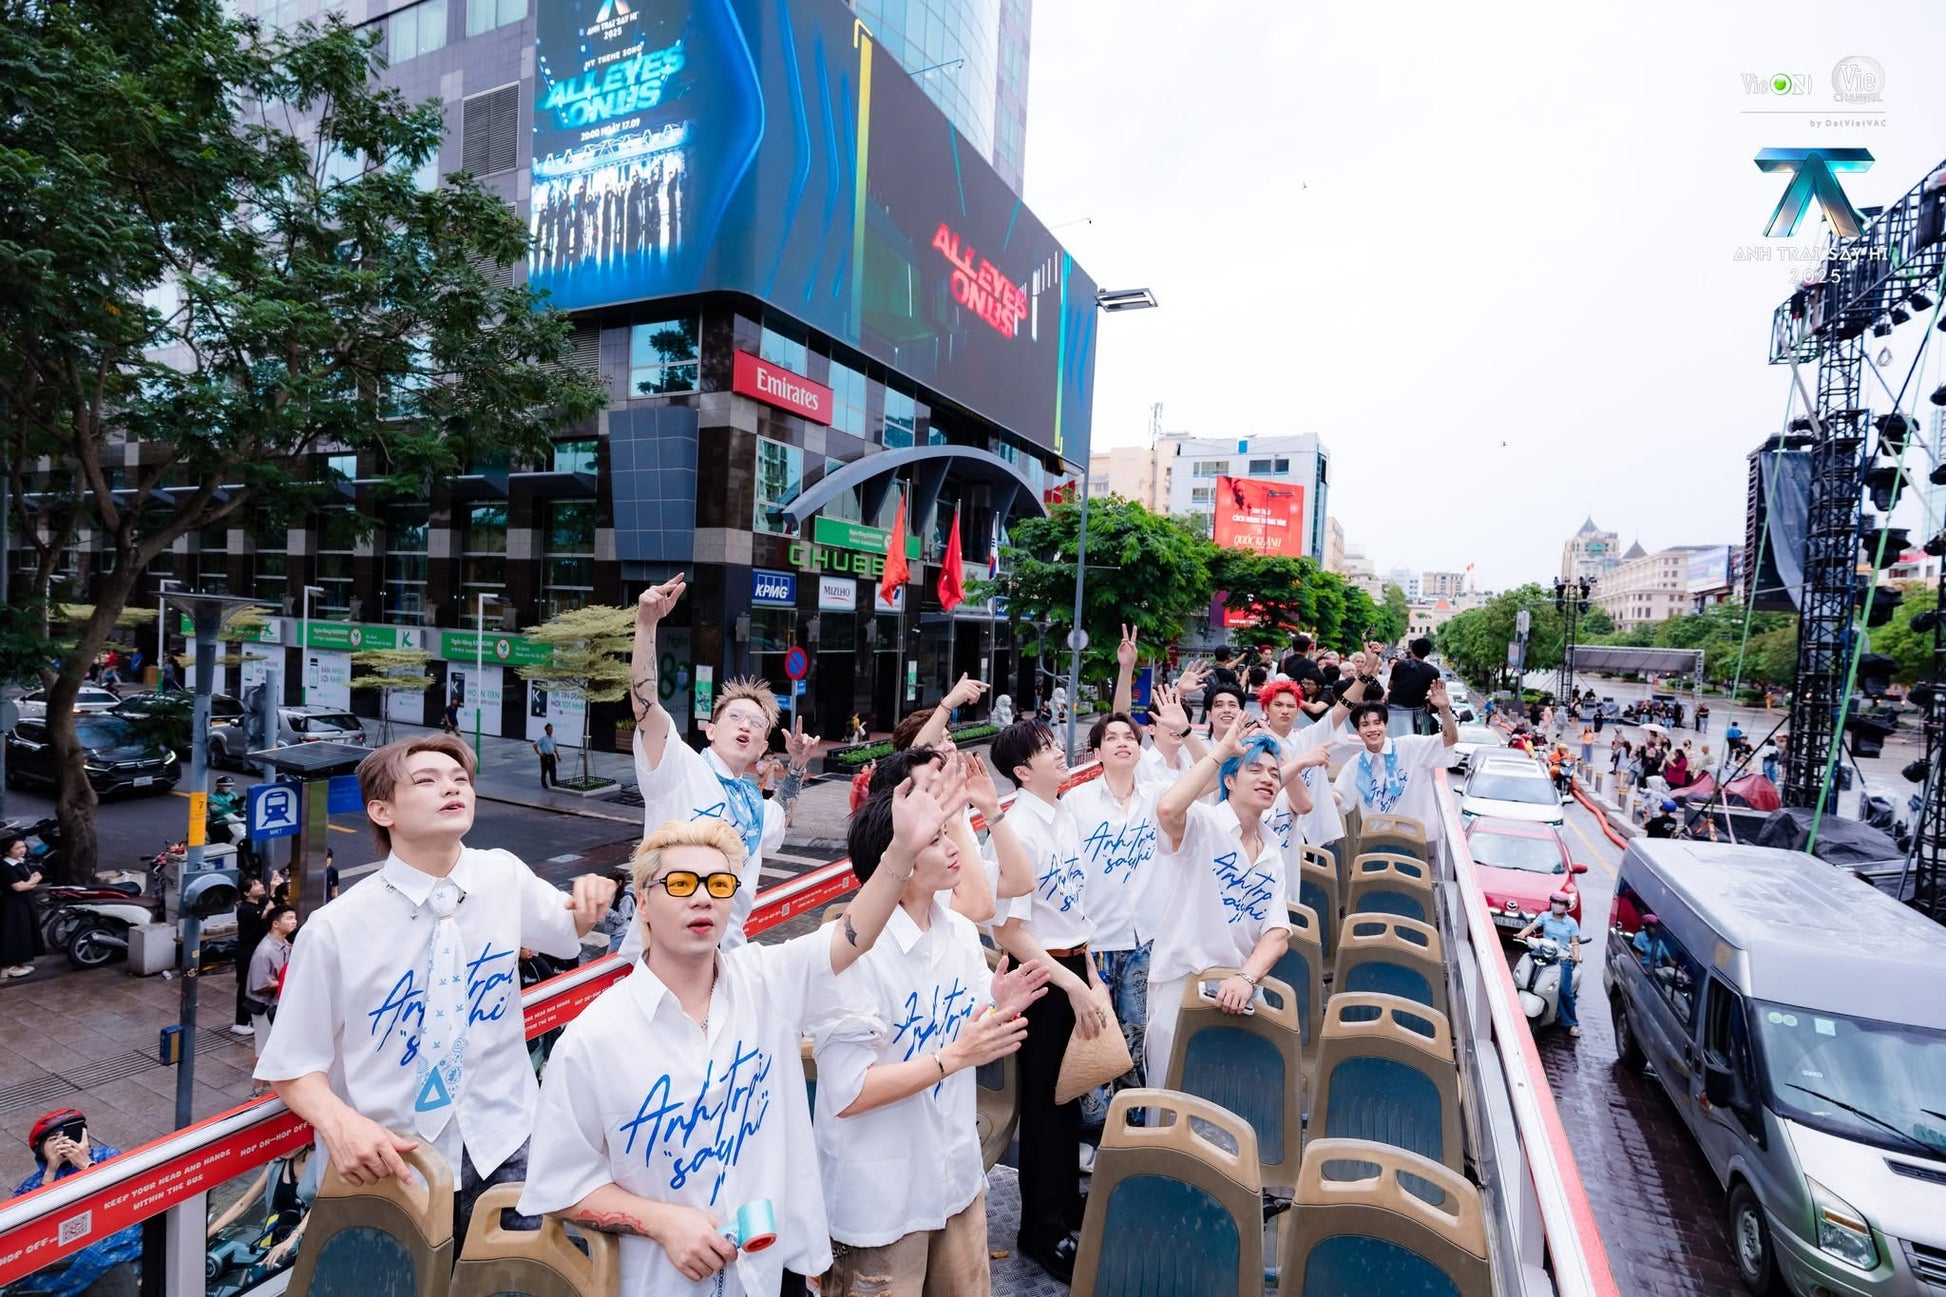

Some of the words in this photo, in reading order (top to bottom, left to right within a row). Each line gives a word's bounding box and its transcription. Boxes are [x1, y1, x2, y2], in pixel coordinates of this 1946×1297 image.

[598, 51, 620, 64] THEME
[622, 44, 643, 57] SONG
[602, 46, 684, 93] EYES
[757, 366, 818, 411] Emirates
[755, 583, 789, 599] KPMG
[532, 690, 540, 702] K
[1084, 822, 1130, 862] Anh
[1213, 851, 1254, 890] Anh
[620, 1060, 723, 1168] Anh
[104, 1193, 129, 1210] KEEP
[132, 1181, 157, 1198] YOUR
[158, 1170, 182, 1187] HEAD
[184, 1161, 202, 1175] AND
[203, 1148, 231, 1166] HANDS
[240, 1144, 257, 1157] HOP
[133, 1192, 165, 1211] WITHIN
[167, 1182, 184, 1194] THE
[186, 1173, 204, 1187] BUS
